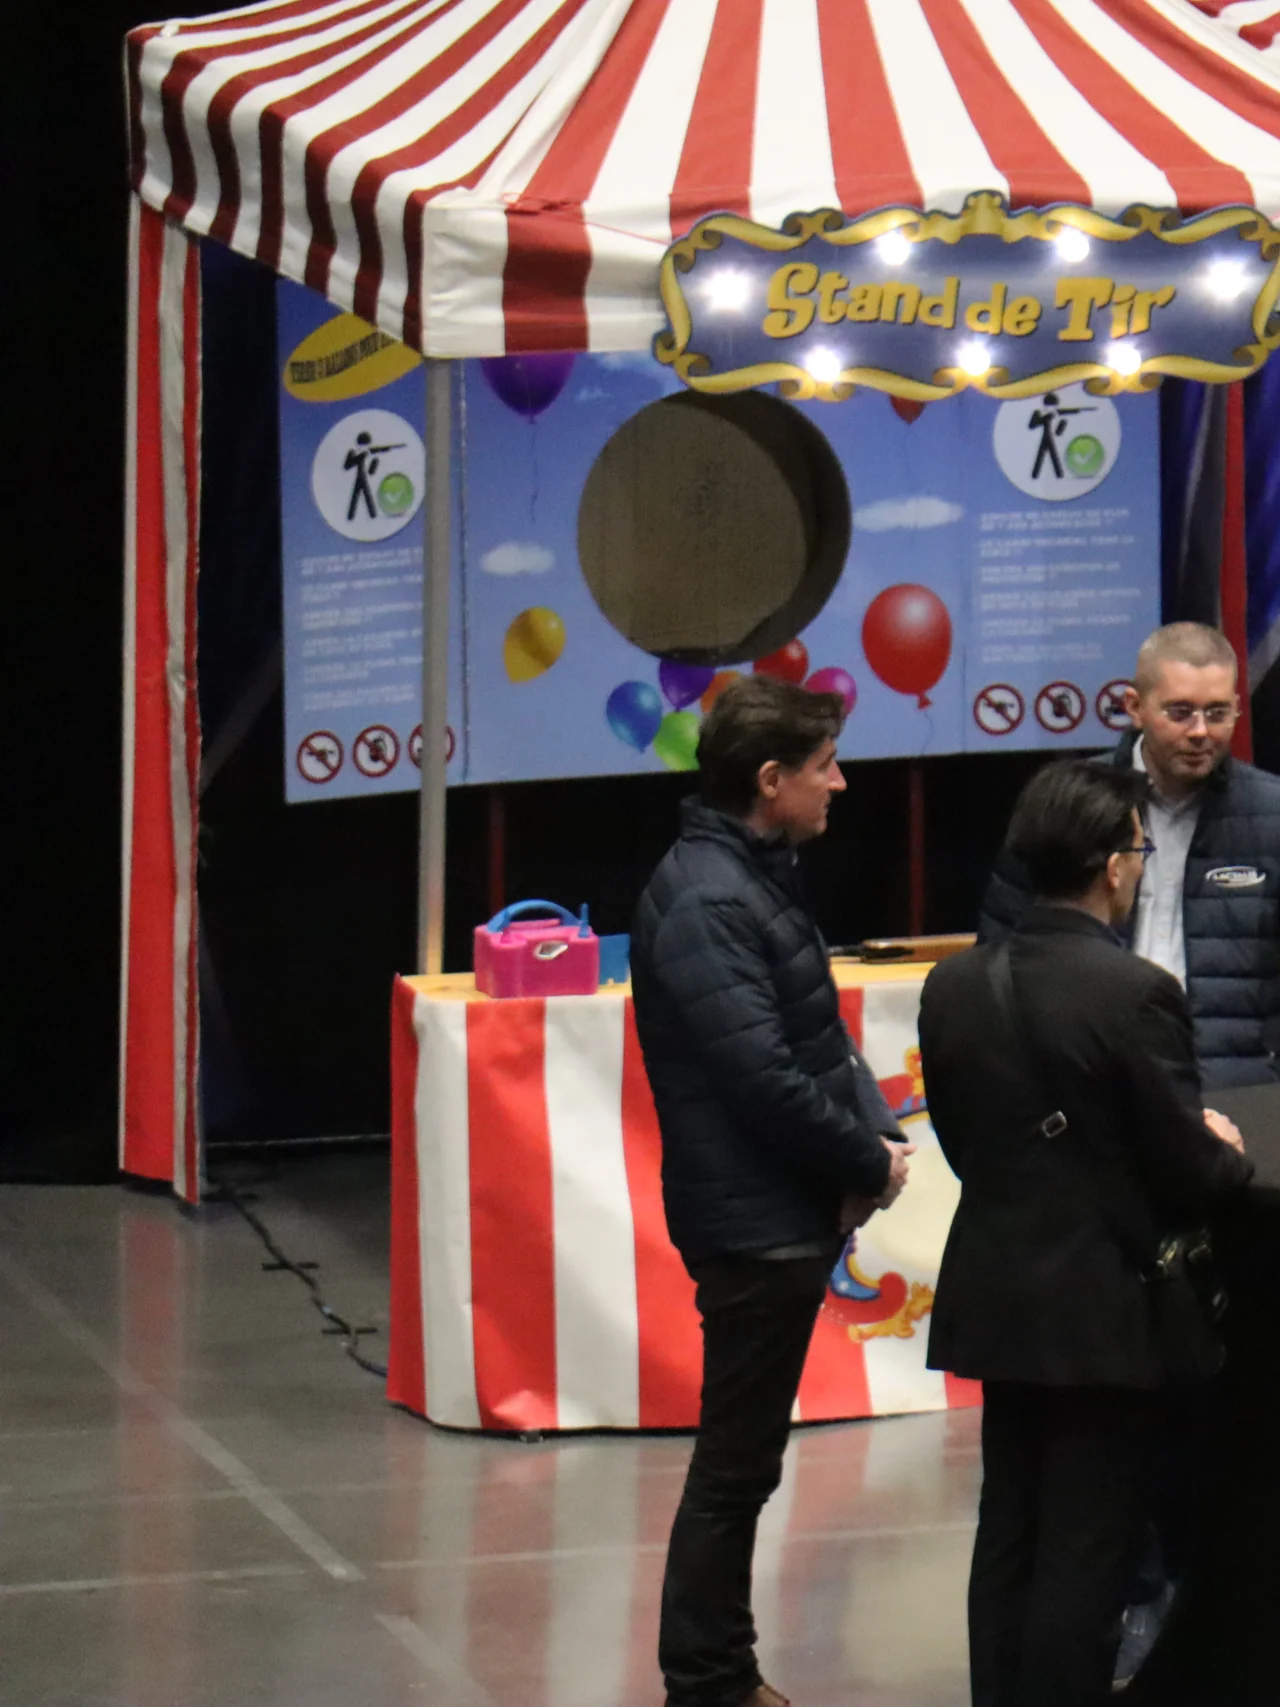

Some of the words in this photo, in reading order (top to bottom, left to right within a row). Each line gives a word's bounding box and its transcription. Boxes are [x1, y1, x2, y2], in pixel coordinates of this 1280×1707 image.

[763, 262, 960, 339] Stand
[965, 282, 1042, 337] de
[1054, 277, 1177, 341] Tir
